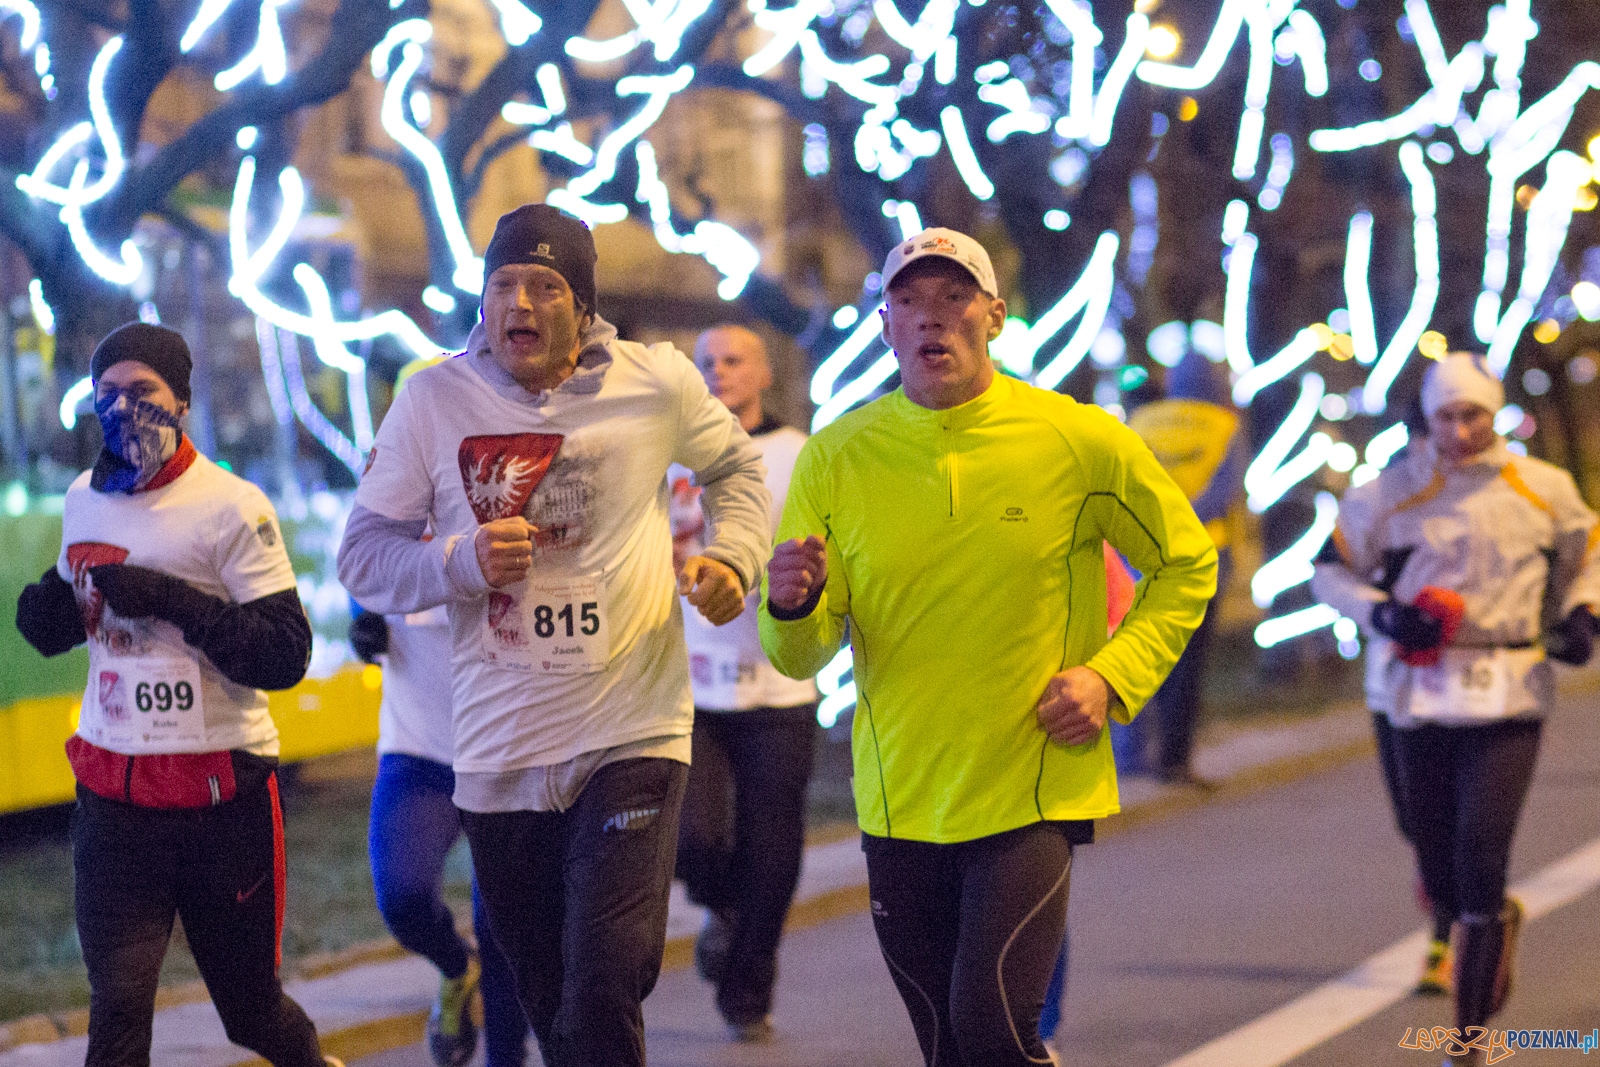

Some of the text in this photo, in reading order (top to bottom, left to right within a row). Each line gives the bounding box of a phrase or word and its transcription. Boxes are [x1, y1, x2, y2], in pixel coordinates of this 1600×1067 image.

[534, 601, 600, 638] 815
[552, 645, 584, 655] Jacek
[136, 681, 194, 712] 699
